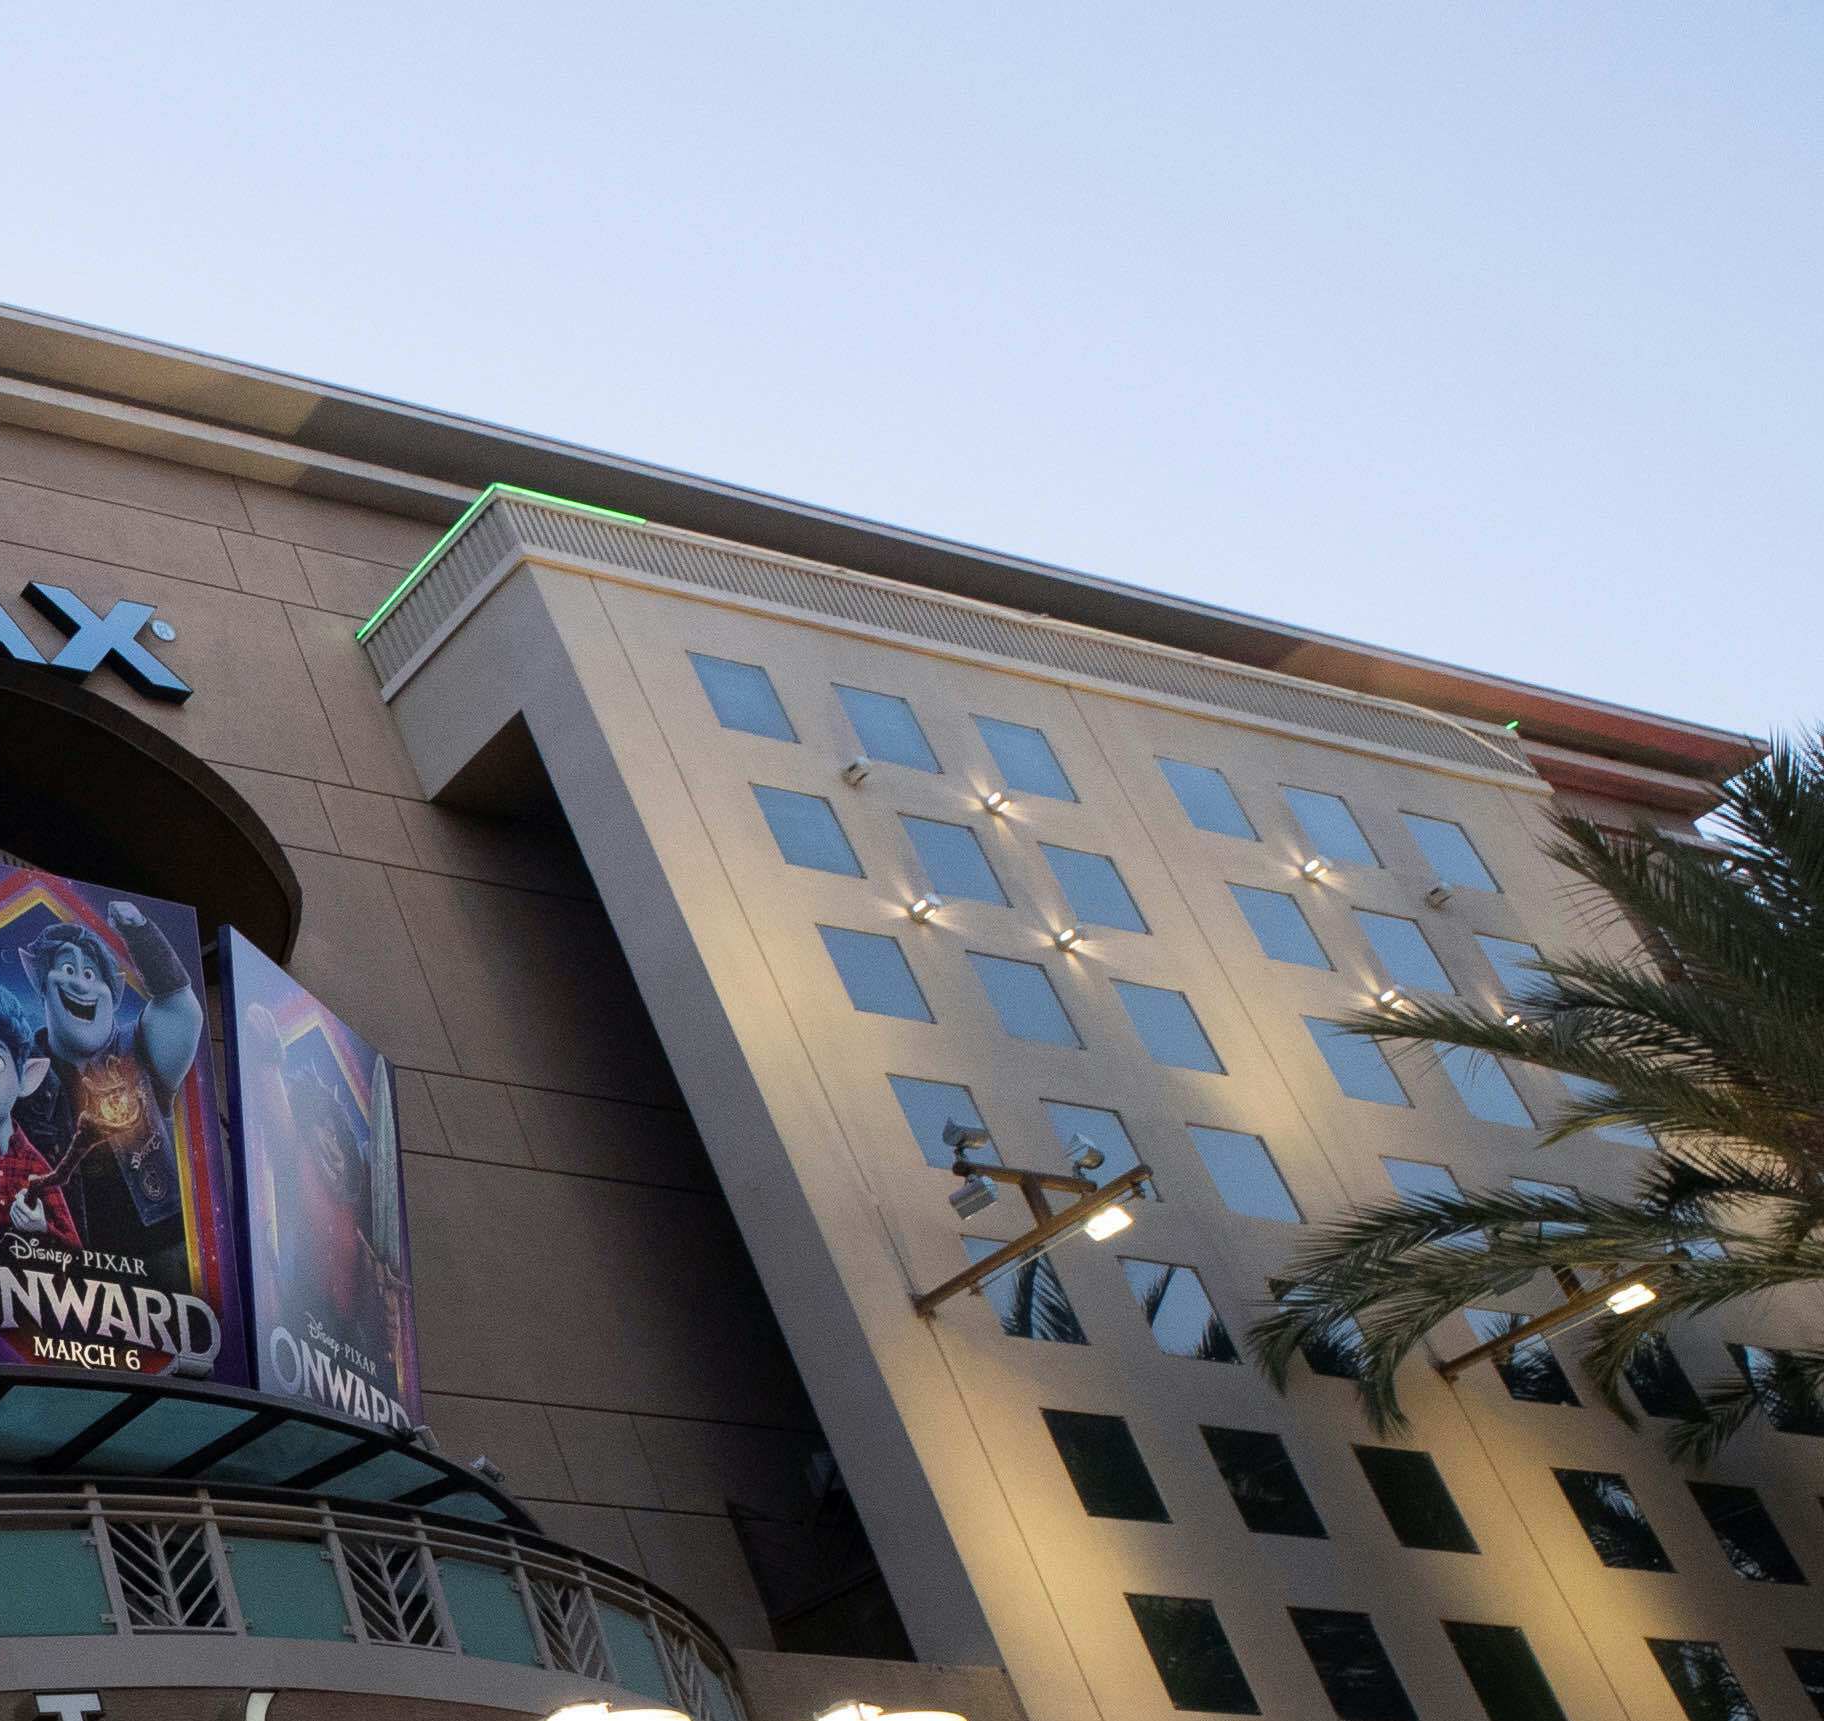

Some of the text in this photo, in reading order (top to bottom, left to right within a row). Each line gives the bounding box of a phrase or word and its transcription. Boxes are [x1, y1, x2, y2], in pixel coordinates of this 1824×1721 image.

[82, 1250, 148, 1277] PIXAR
[32, 1336, 141, 1371] MARCH 6
[344, 1346, 378, 1377] PIXAR
